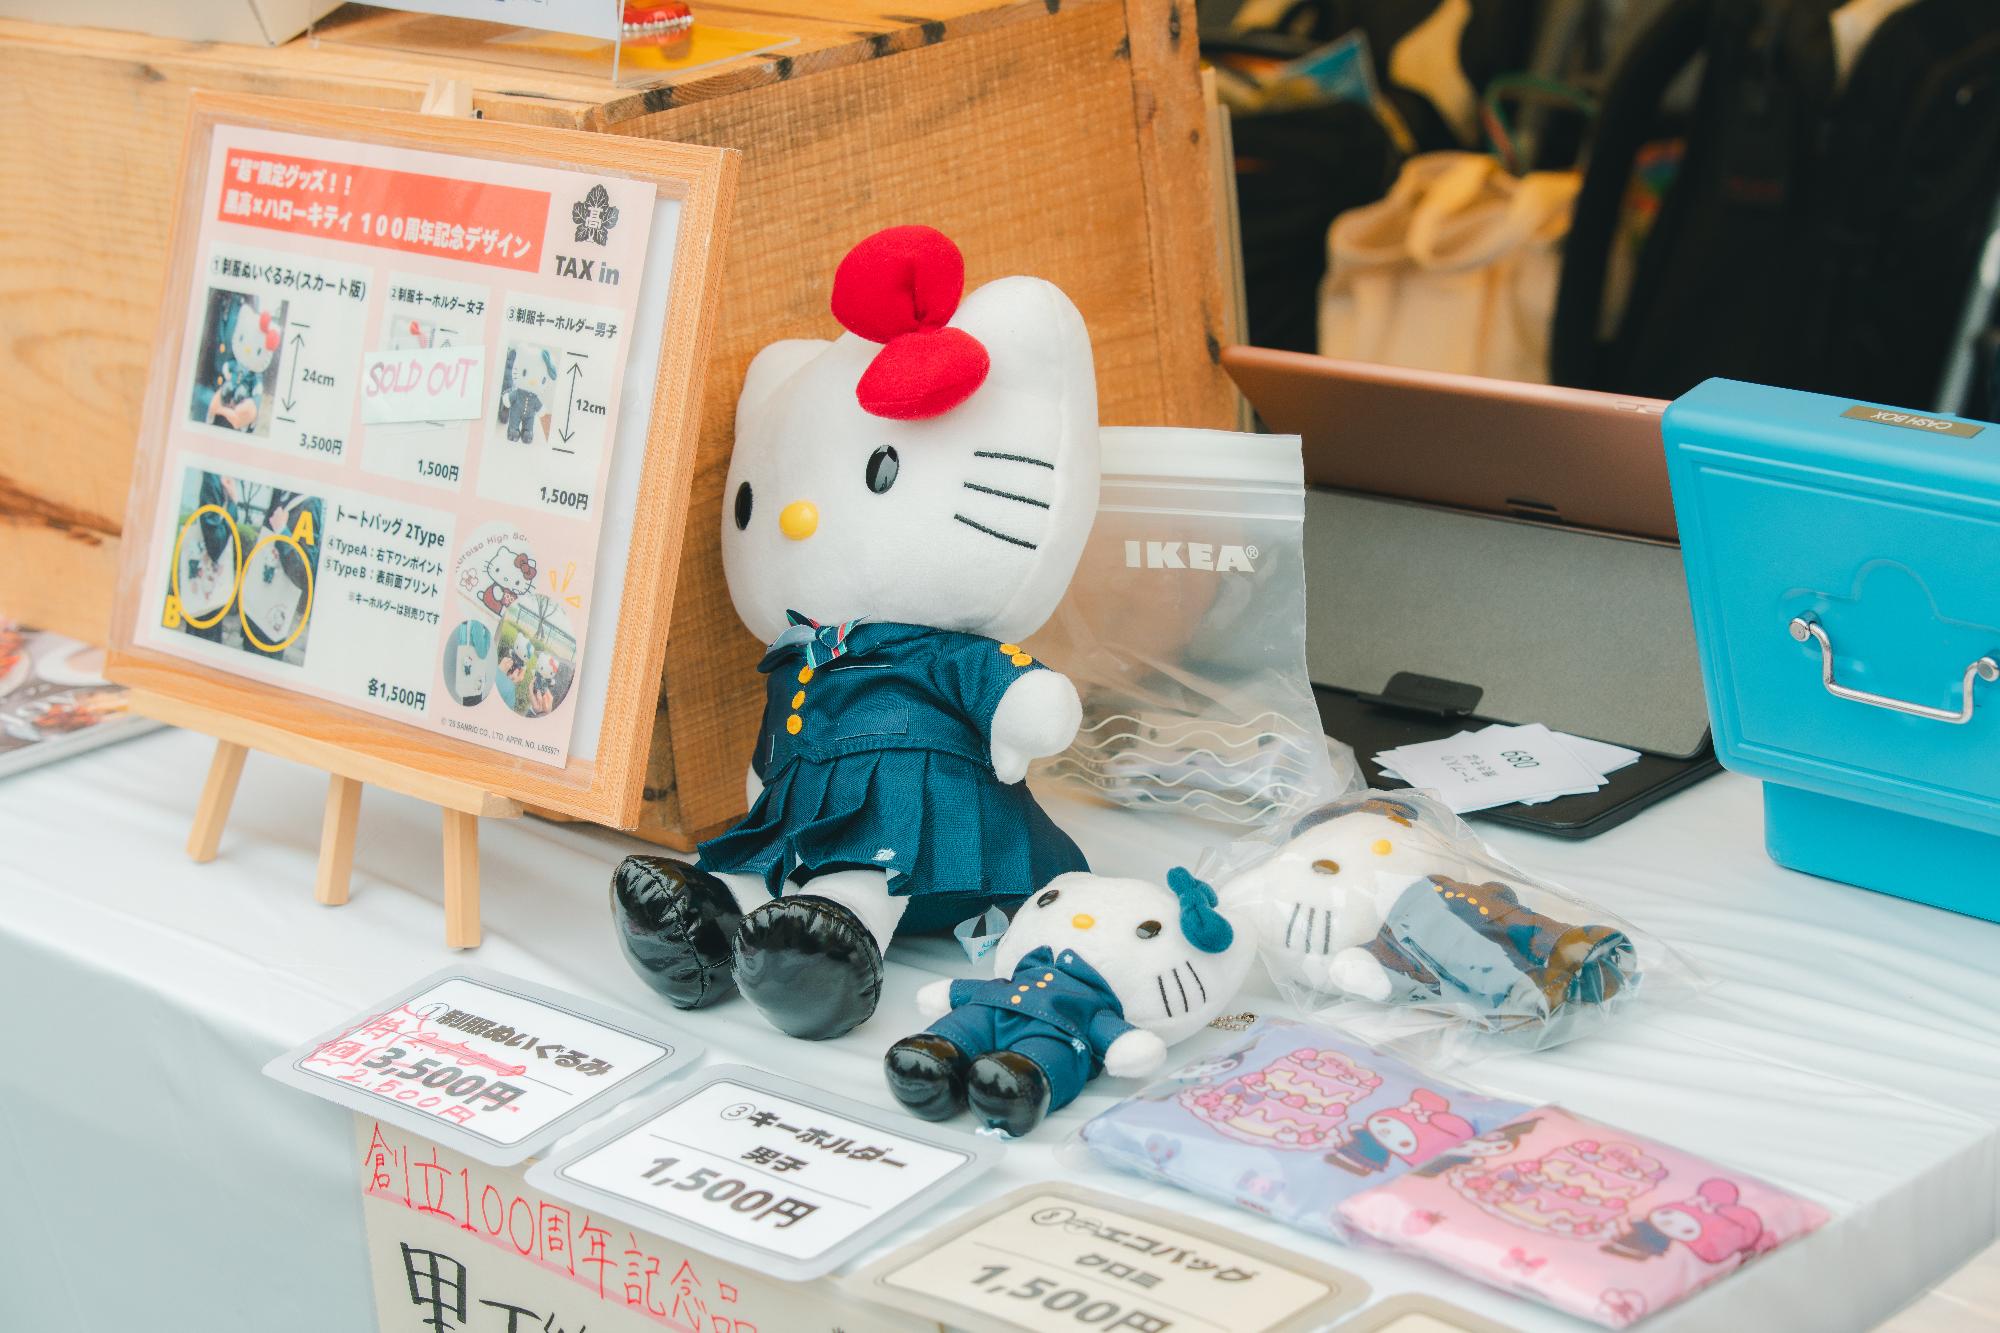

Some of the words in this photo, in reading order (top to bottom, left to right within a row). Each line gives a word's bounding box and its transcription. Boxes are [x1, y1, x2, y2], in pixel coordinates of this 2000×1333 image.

[555, 254, 595, 282] TAX
[598, 261, 620, 286] in
[301, 368, 335, 388] 24cm
[366, 359, 424, 398] SOLD
[427, 357, 479, 399] OUT
[576, 398, 606, 416] 12cm
[1871, 411, 1908, 424] BOX
[1908, 416, 1953, 430] CASH
[299, 432, 343, 456] 3,500円
[417, 459, 460, 483] 1,500円
[540, 486, 589, 511] 1,500円
[291, 511, 315, 545] A
[336, 504, 403, 537] トートバッグ
[405, 522, 445, 548] 2Type
[161, 594, 182, 629] B
[367, 677, 427, 711] 各1,500円
[361, 1046, 528, 1112] 3,500円
[739, 1145, 810, 1173] 男子
[639, 1156, 822, 1229] 1,500円
[970, 1263, 1174, 1333] 1,500円
